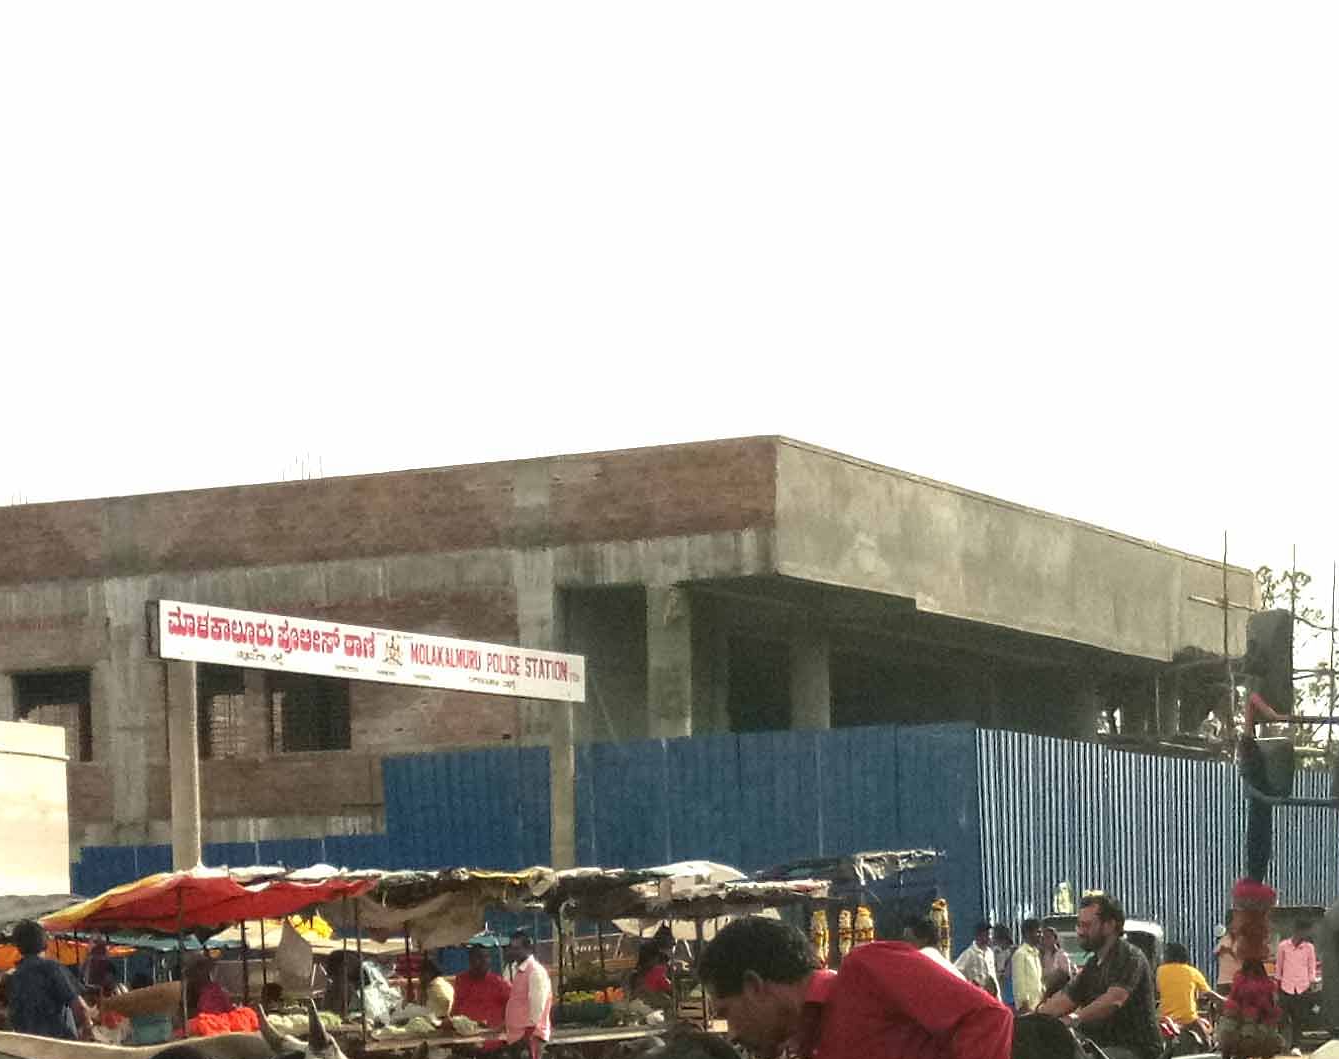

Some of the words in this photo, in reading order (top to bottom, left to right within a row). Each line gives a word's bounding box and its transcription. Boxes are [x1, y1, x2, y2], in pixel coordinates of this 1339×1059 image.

[410, 643, 481, 672] MOLAKALMURU
[486, 652, 520, 676] POLICE
[524, 654, 568, 683] STATION
